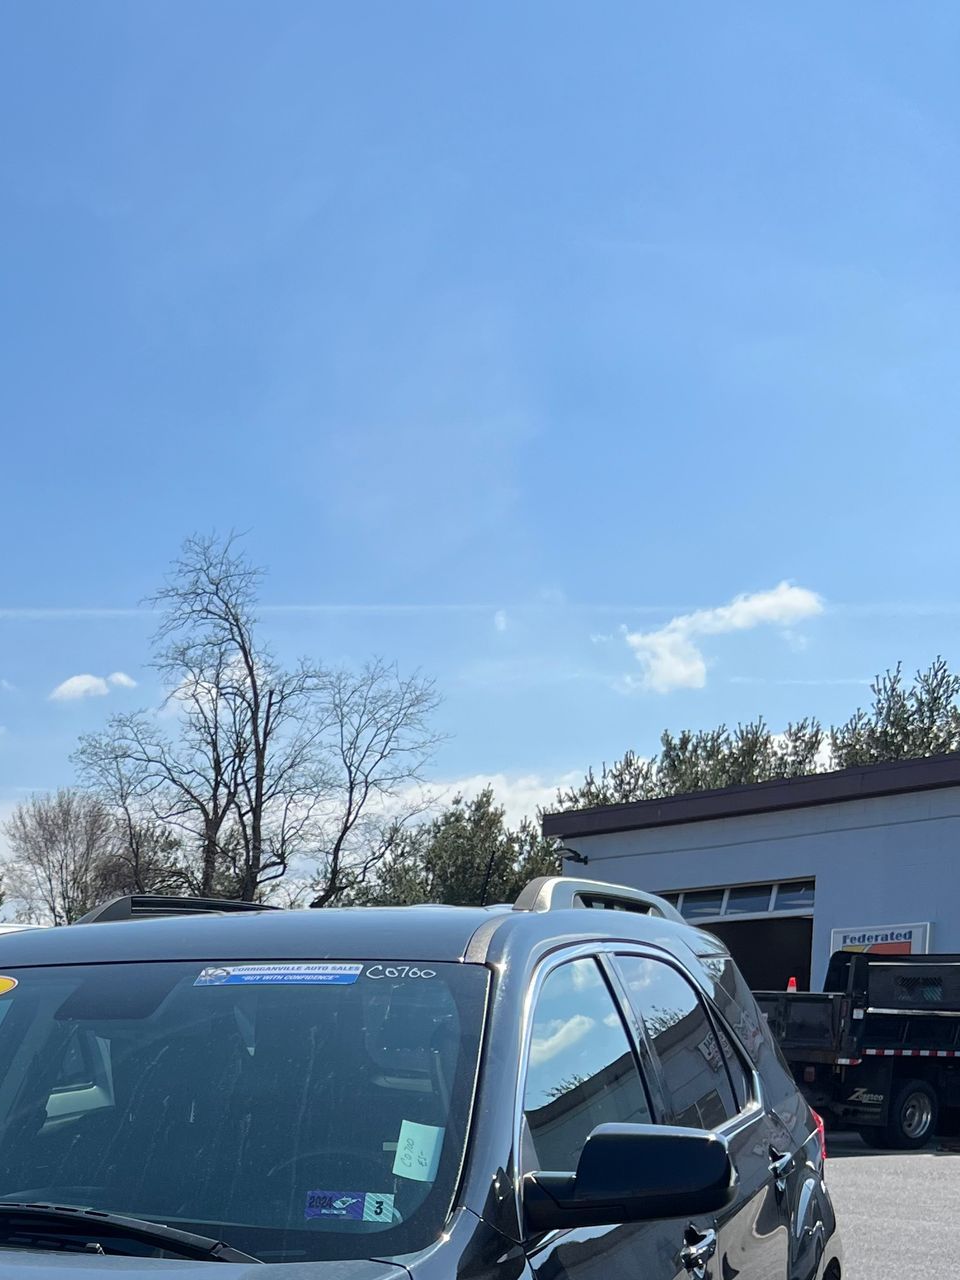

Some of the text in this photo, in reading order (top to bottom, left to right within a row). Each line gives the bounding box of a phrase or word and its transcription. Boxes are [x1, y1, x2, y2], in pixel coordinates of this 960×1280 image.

[842, 930, 913, 944] Federated
[308, 1196, 333, 1208] 2024
[374, 1201, 384, 1216] 3
